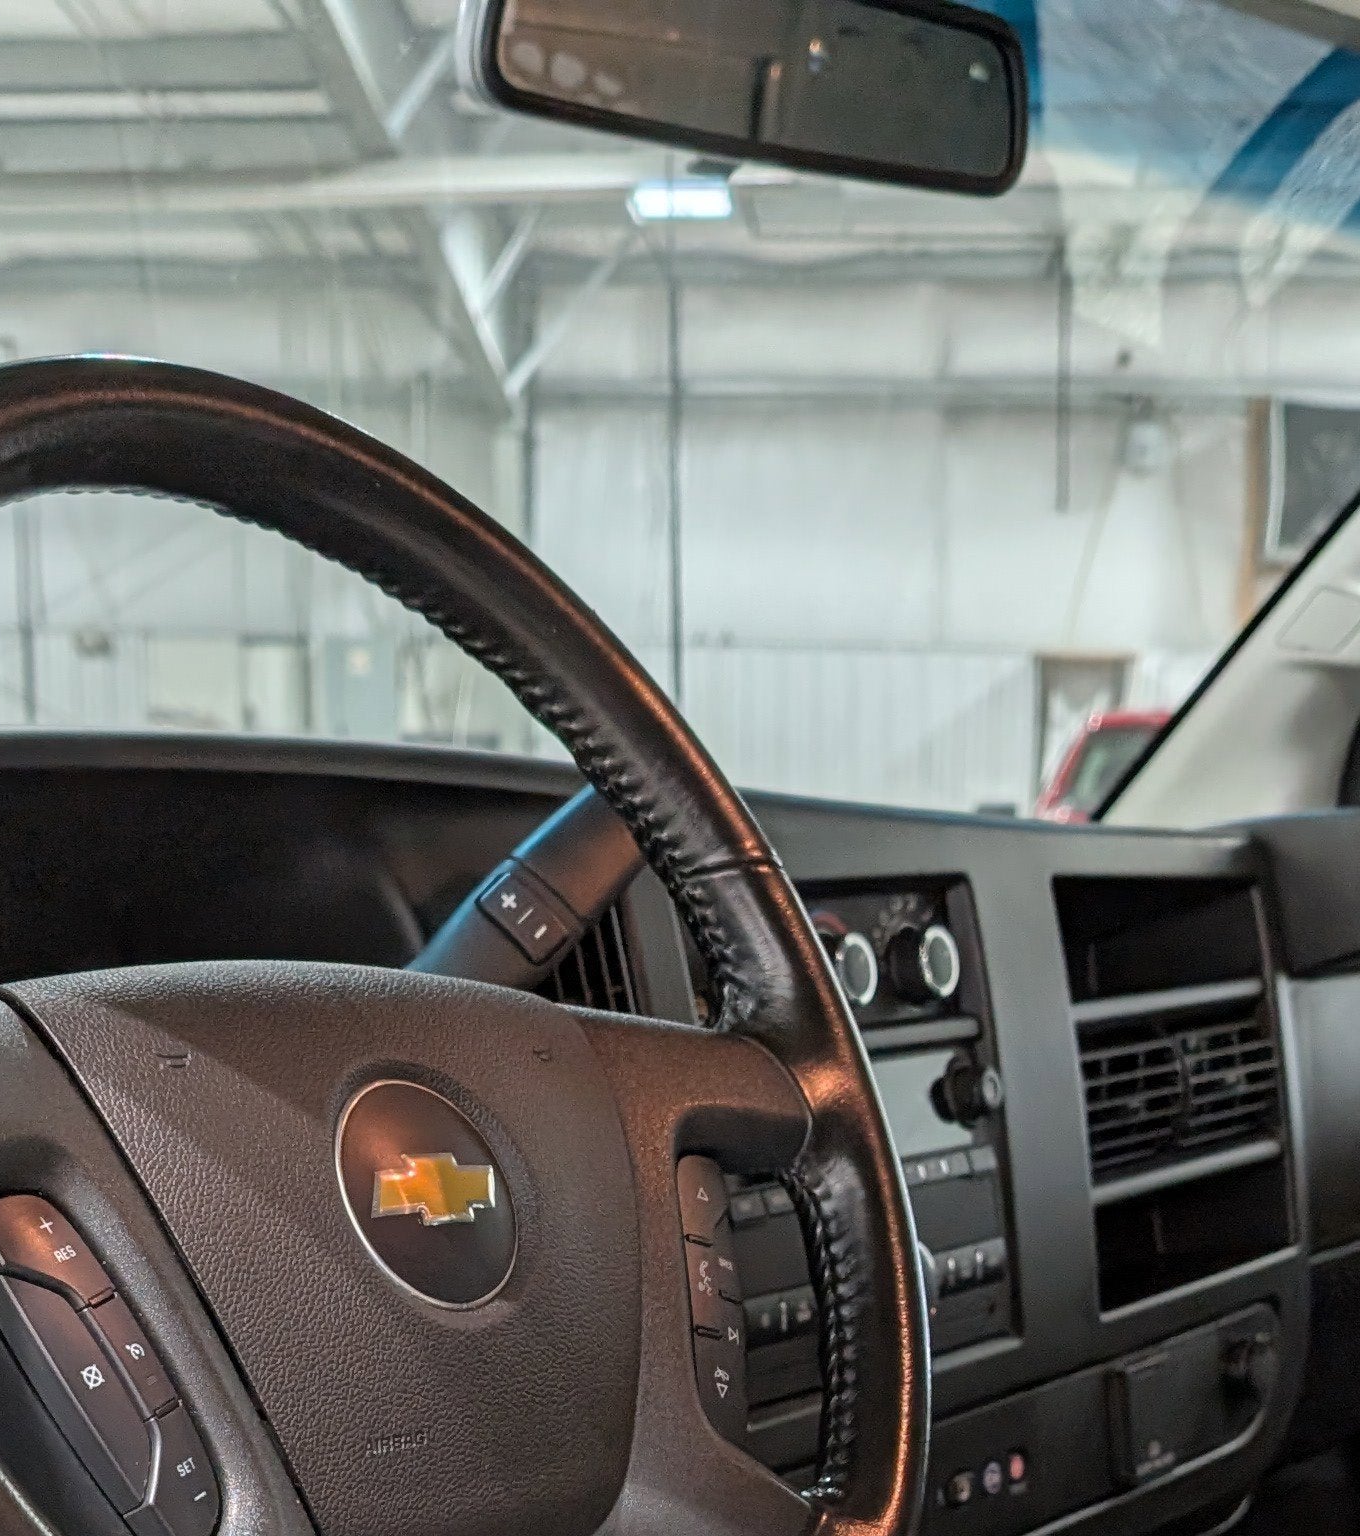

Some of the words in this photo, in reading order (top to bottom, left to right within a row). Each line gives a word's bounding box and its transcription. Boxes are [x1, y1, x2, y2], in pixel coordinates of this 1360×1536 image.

[53, 1244, 77, 1264] RES
[366, 1431, 428, 1457] AIRBAG
[176, 1456, 196, 1477] SET
